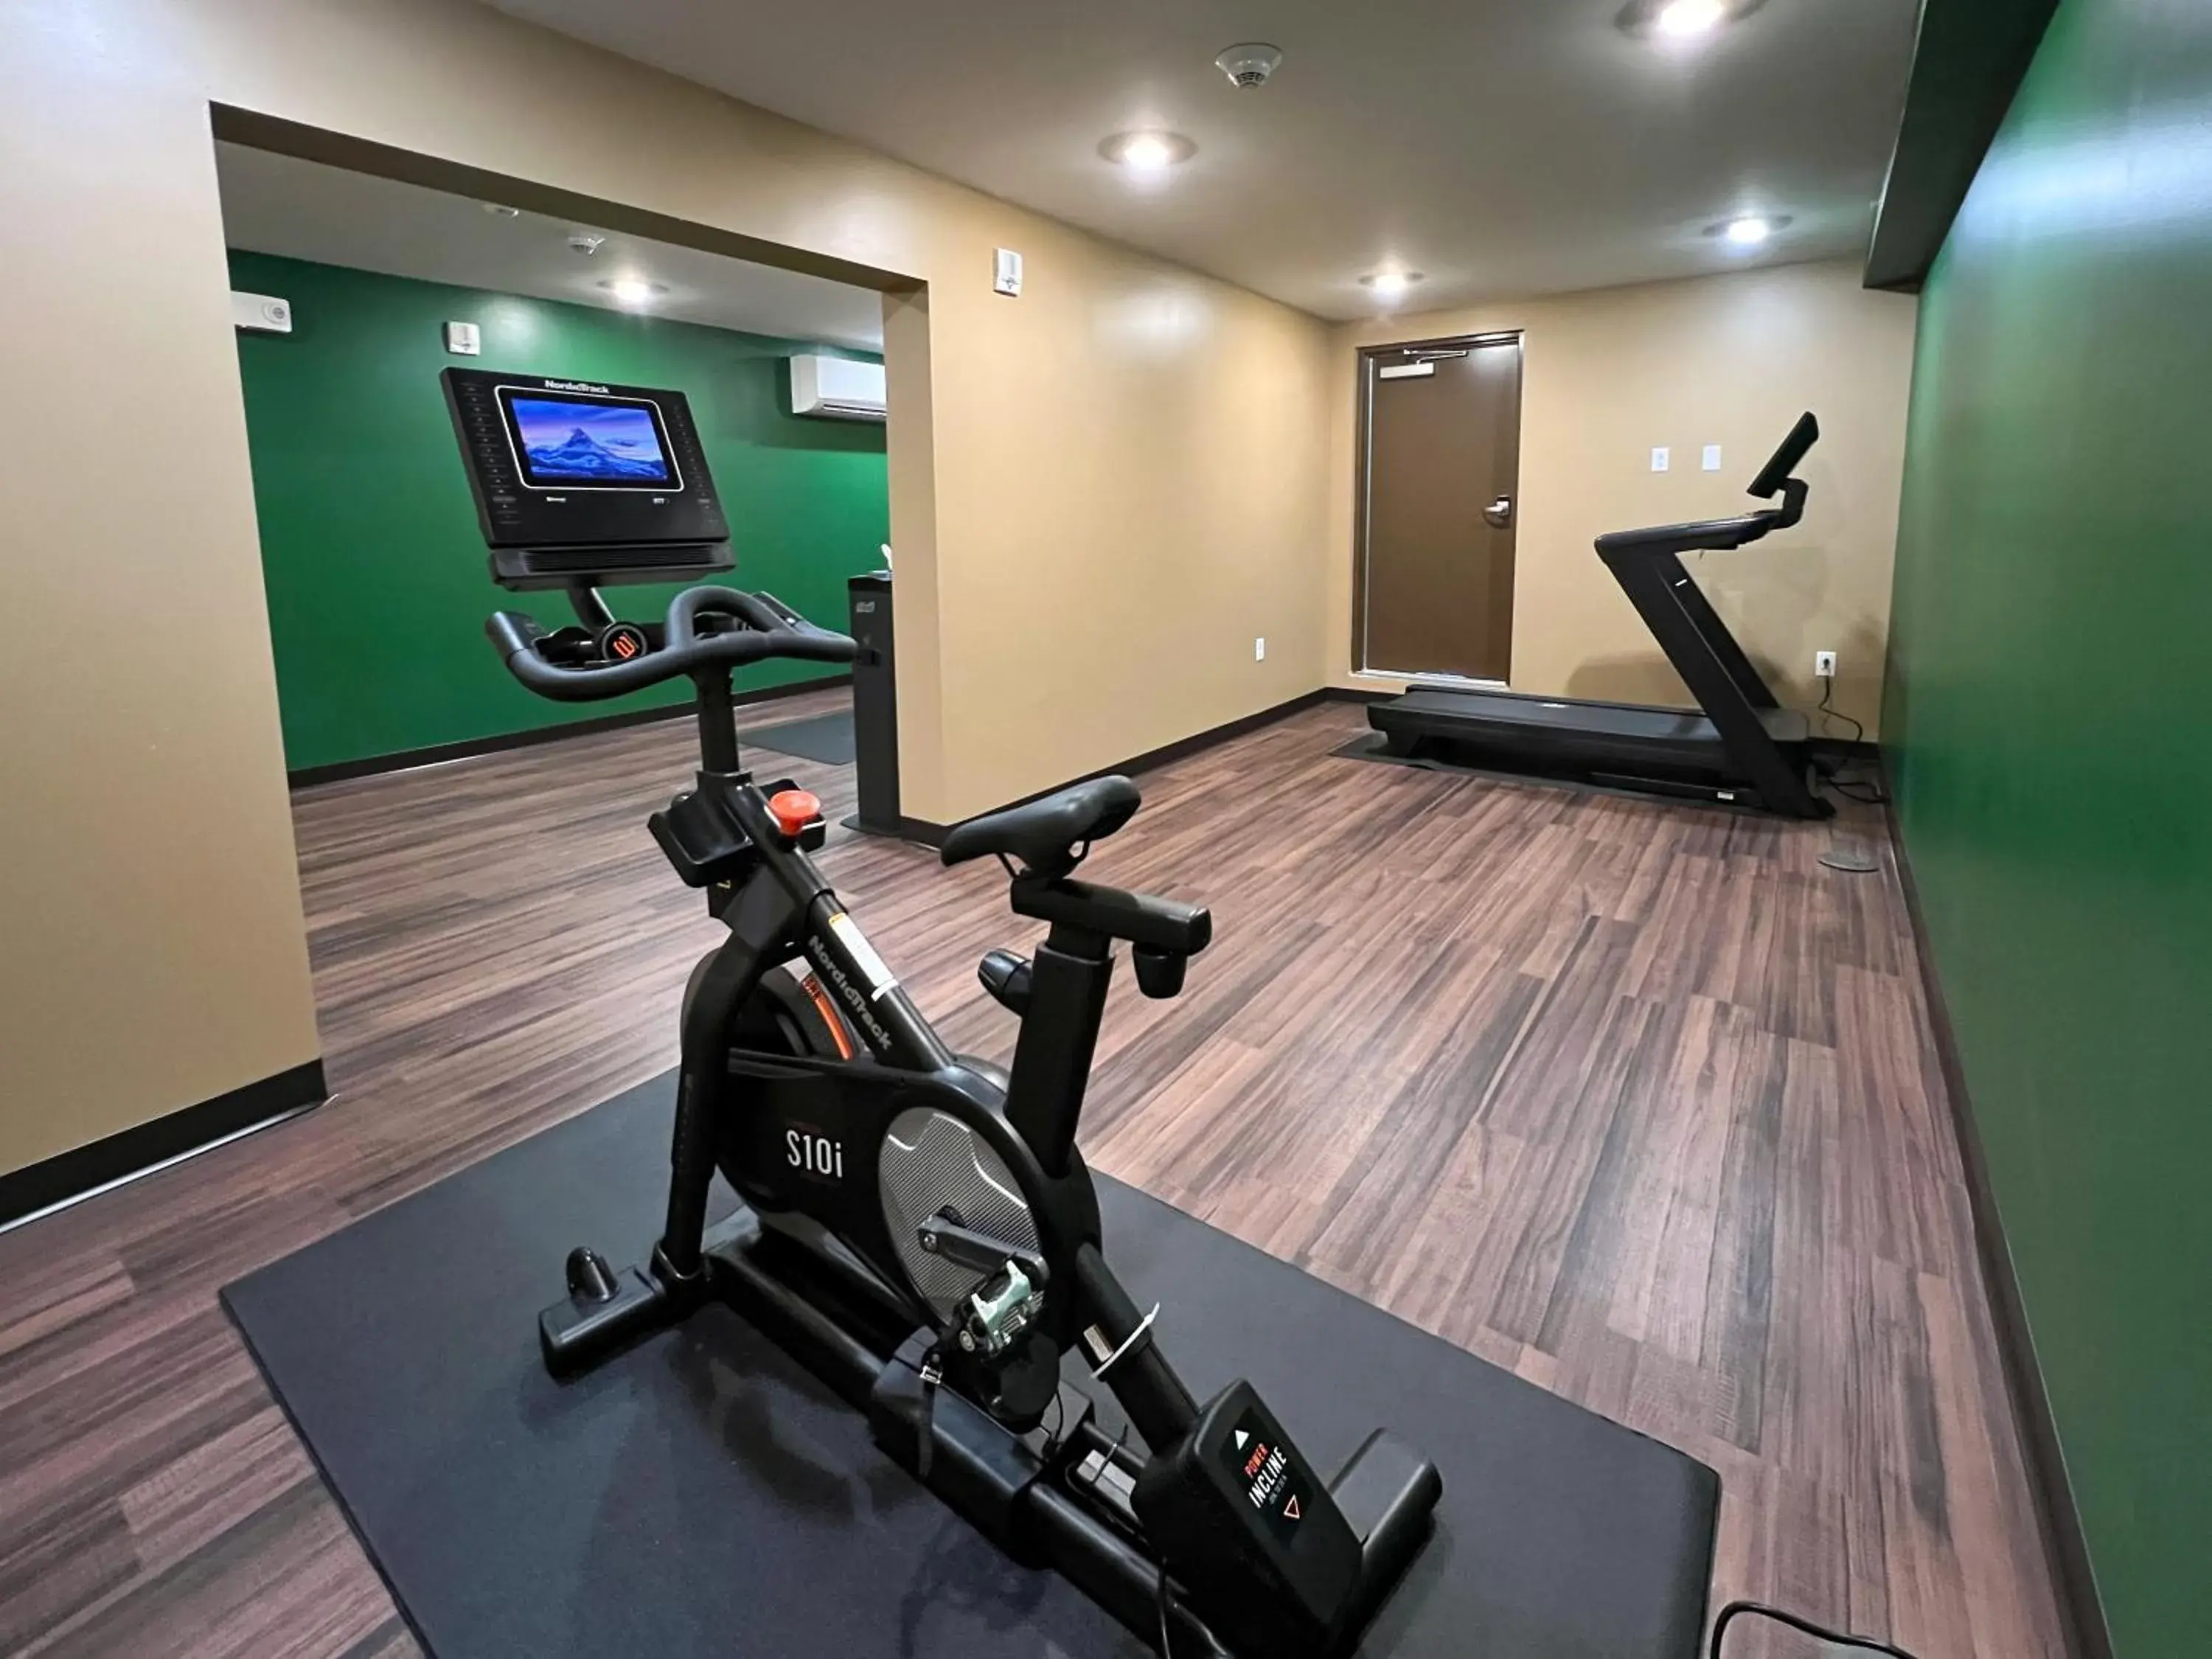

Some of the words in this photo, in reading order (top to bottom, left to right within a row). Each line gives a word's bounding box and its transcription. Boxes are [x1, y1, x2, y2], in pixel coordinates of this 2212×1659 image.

[544, 379, 610, 394] NordicTrack
[808, 935, 893, 1051] NordicTrack
[786, 1129, 843, 1178] S10i
[1248, 1445, 1287, 1509] INCLINE
